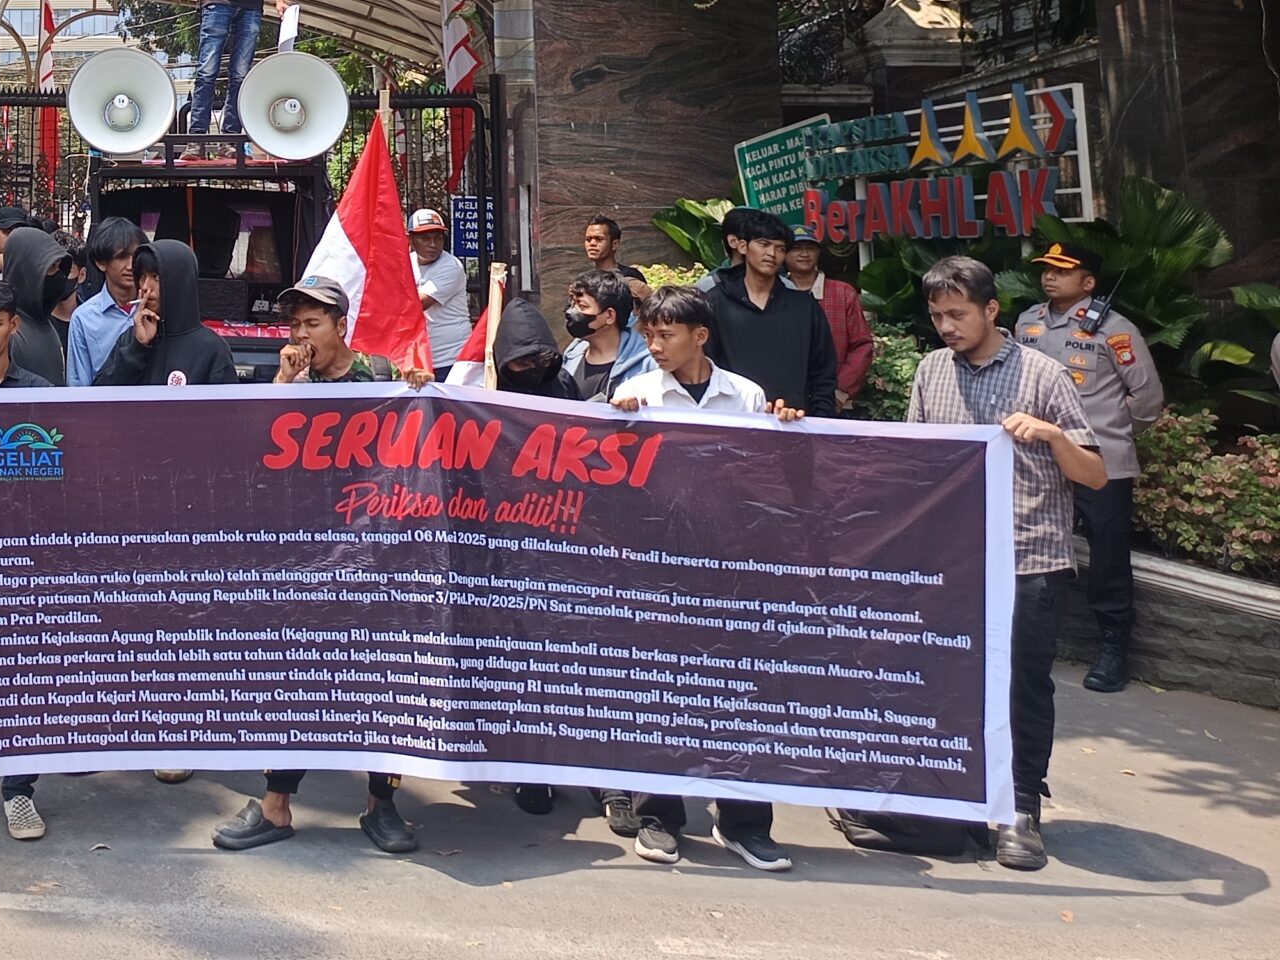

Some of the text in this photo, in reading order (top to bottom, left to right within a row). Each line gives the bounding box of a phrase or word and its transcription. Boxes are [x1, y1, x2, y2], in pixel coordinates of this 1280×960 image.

[745, 143, 779, 164] KELUAR
[744, 163, 767, 179] KACA
[768, 153, 796, 171] PINTU
[753, 169, 796, 191] DAN KACA
[759, 187, 787, 204] HARAP
[1065, 340, 1095, 352] POLRI
[262, 409, 664, 488] SERUAN AKSI
[25, 467, 64, 476] NEGERI
[336, 481, 443, 525] Periksa
[448, 488, 488, 522] dan
[30, 533, 72, 545] tindak
[74, 532, 118, 547] pidana
[122, 531, 189, 546] perusakan
[192, 530, 244, 544] gembok
[247, 530, 276, 541] ruko
[279, 530, 311, 544] pada
[314, 530, 358, 543] selasa,
[361, 530, 412, 544] tanggal
[415, 530, 432, 542] 06
[458, 532, 486, 545] 2025
[488, 538, 518, 550] yang
[521, 538, 588, 554] dilakukan
[590, 545, 618, 558] oleh
[622, 548, 659, 562] Fendi
[662, 552, 718, 568] berserta
[722, 559, 825, 577] rombongannya
[829, 567, 868, 580] tanpa
[872, 571, 943, 584] mengikuti
[30, 572, 97, 587] perusakan
[101, 571, 130, 583] ruko
[133, 570, 188, 585] (gembok
[191, 569, 224, 582] ruko)
[227, 569, 260, 581] telah
[263, 568, 333, 583] melanggar
[335, 570, 446, 585] Undang-undang.
[449, 572, 488, 587] Dengan
[491, 575, 545, 591] kerugian
[548, 583, 613, 598] mencapai
[616, 590, 670, 603] ratusan
[671, 592, 700, 606] juta
[703, 599, 760, 610] menurut
[763, 601, 827, 619] pendapat
[830, 605, 856, 618] ahli
[860, 607, 922, 623] ekonomi.
[11, 614, 33, 625] Pra
[36, 612, 101, 624] Peradilan.
[38, 594, 90, 607] putusan
[94, 590, 166, 602] Mahkamah
[169, 590, 210, 604] Agung
[214, 589, 270, 604] Republik
[273, 588, 336, 600] Indonesia
[339, 589, 388, 603] dengan
[389, 590, 434, 602] Nomor
[550, 600, 572, 612] Snt
[575, 605, 633, 618] menolak
[636, 611, 722, 627] permohonan
[726, 620, 760, 632] yang
[778, 621, 824, 635] ajukan
[828, 624, 868, 638] pihak
[870, 629, 920, 644] telapor
[922, 632, 970, 649] (Fendi)
[42, 632, 109, 646] Kejaksaan
[112, 631, 153, 644] Agung
[156, 629, 213, 644] Republik
[216, 628, 279, 640] Indonesia
[282, 627, 348, 642] (Kejagung
[351, 628, 369, 642] RI)
[372, 630, 411, 642] untuk
[413, 632, 474, 646] melakukan
[476, 636, 542, 651] peninjauan
[545, 640, 597, 655] kembali
[600, 647, 629, 658] atas
[632, 647, 677, 662] berkas
[680, 654, 735, 668] perkara
[754, 659, 825, 675] Kejaksaan
[828, 664, 873, 679] Muaro
[875, 668, 924, 684] Jambi.
[13, 730, 487, 752] Graham Hutagoal dan Kasi Pidum, Tommy Detasatria jika terbukti bersalah.
